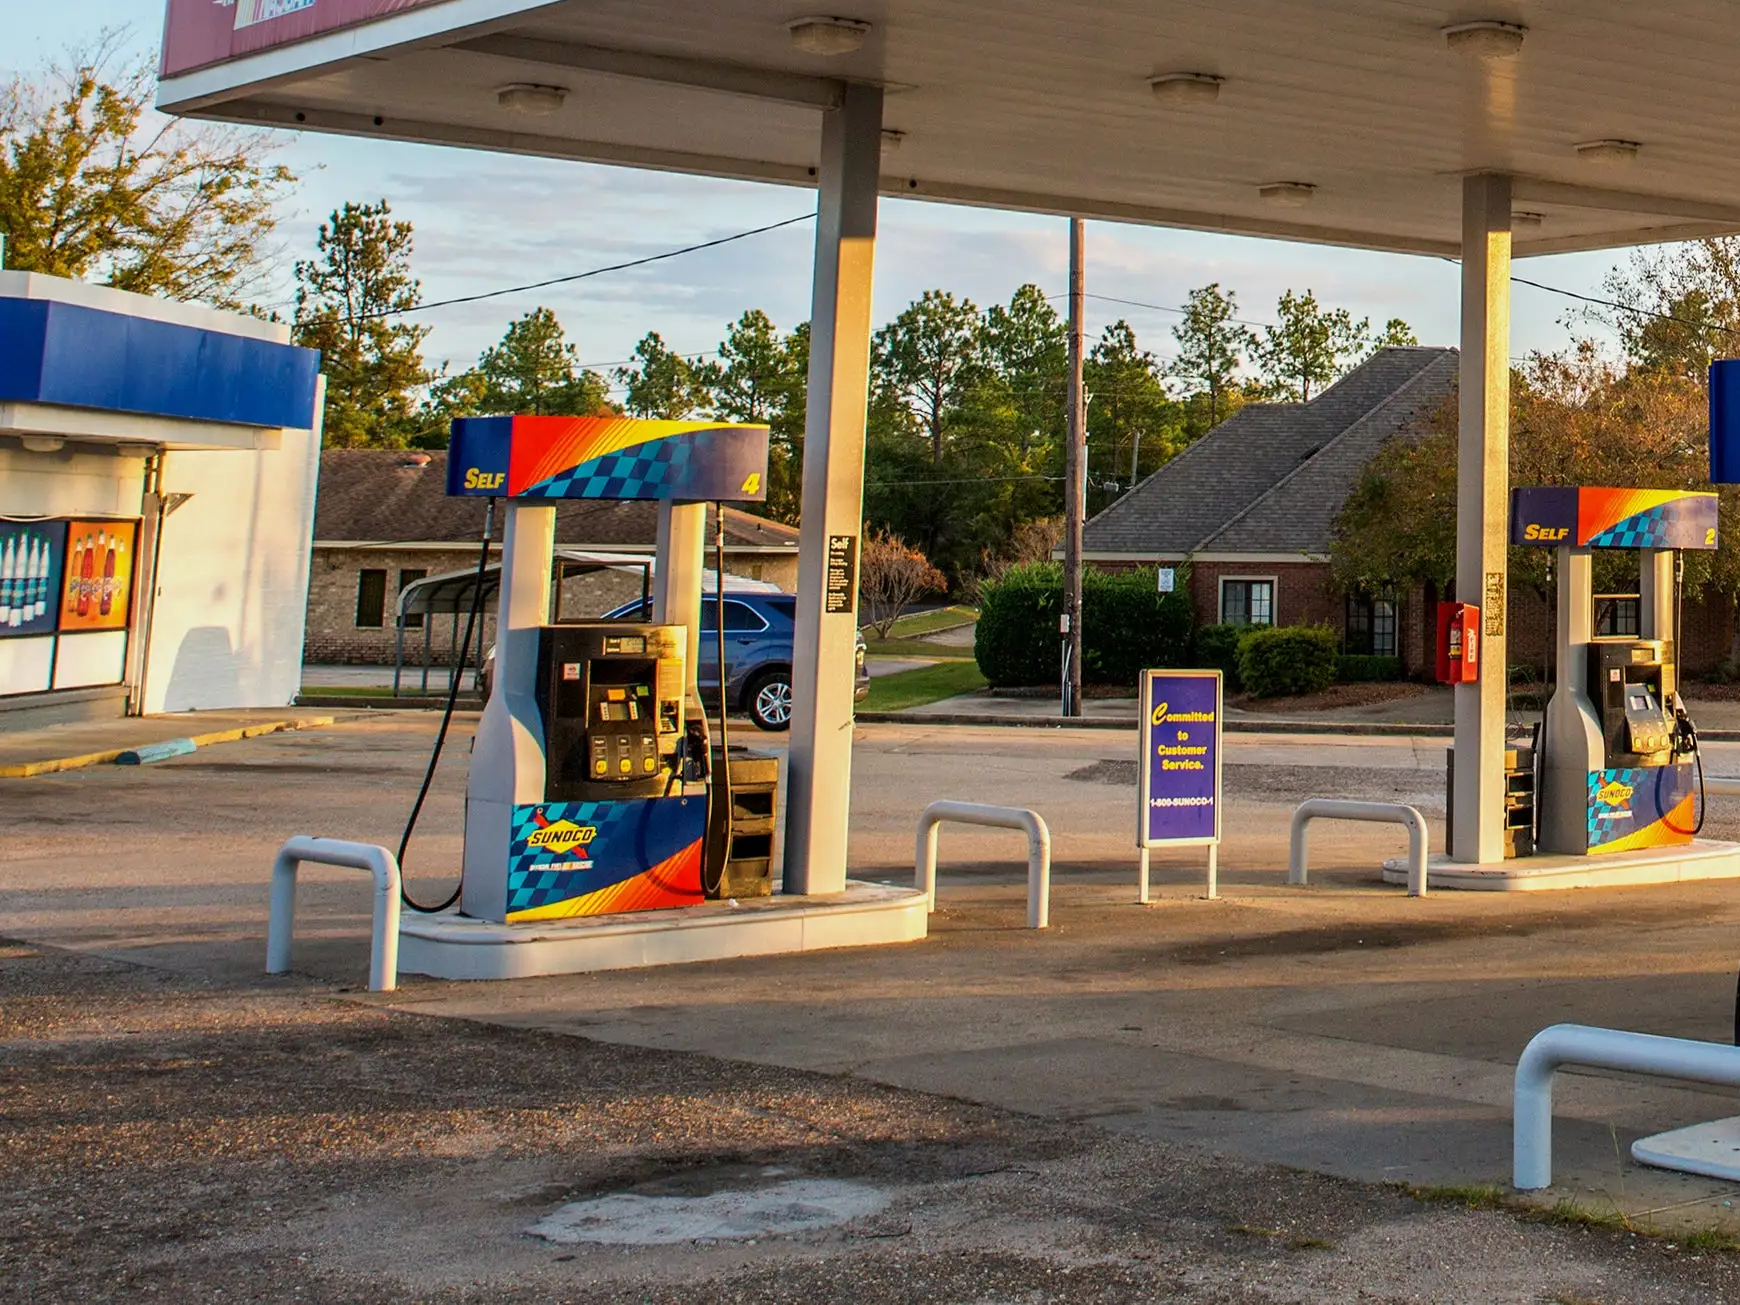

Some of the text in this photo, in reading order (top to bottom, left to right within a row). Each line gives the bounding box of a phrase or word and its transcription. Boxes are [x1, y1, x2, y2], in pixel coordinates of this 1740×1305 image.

[463, 467, 506, 490] SELF
[741, 473, 760, 495] 4
[1523, 523, 1570, 541] SELF
[1704, 527, 1716, 546] 2
[830, 537, 850, 550] Self
[1151, 702, 1215, 726] Committed
[1177, 730, 1189, 741] to
[1157, 745, 1208, 756] Customer
[1161, 759, 1205, 771] Service.
[1598, 787, 1633, 800] SUNOCO
[1150, 797, 1214, 808] 1-800-SUNOCO-1
[530, 828, 594, 845] SUNOCO
